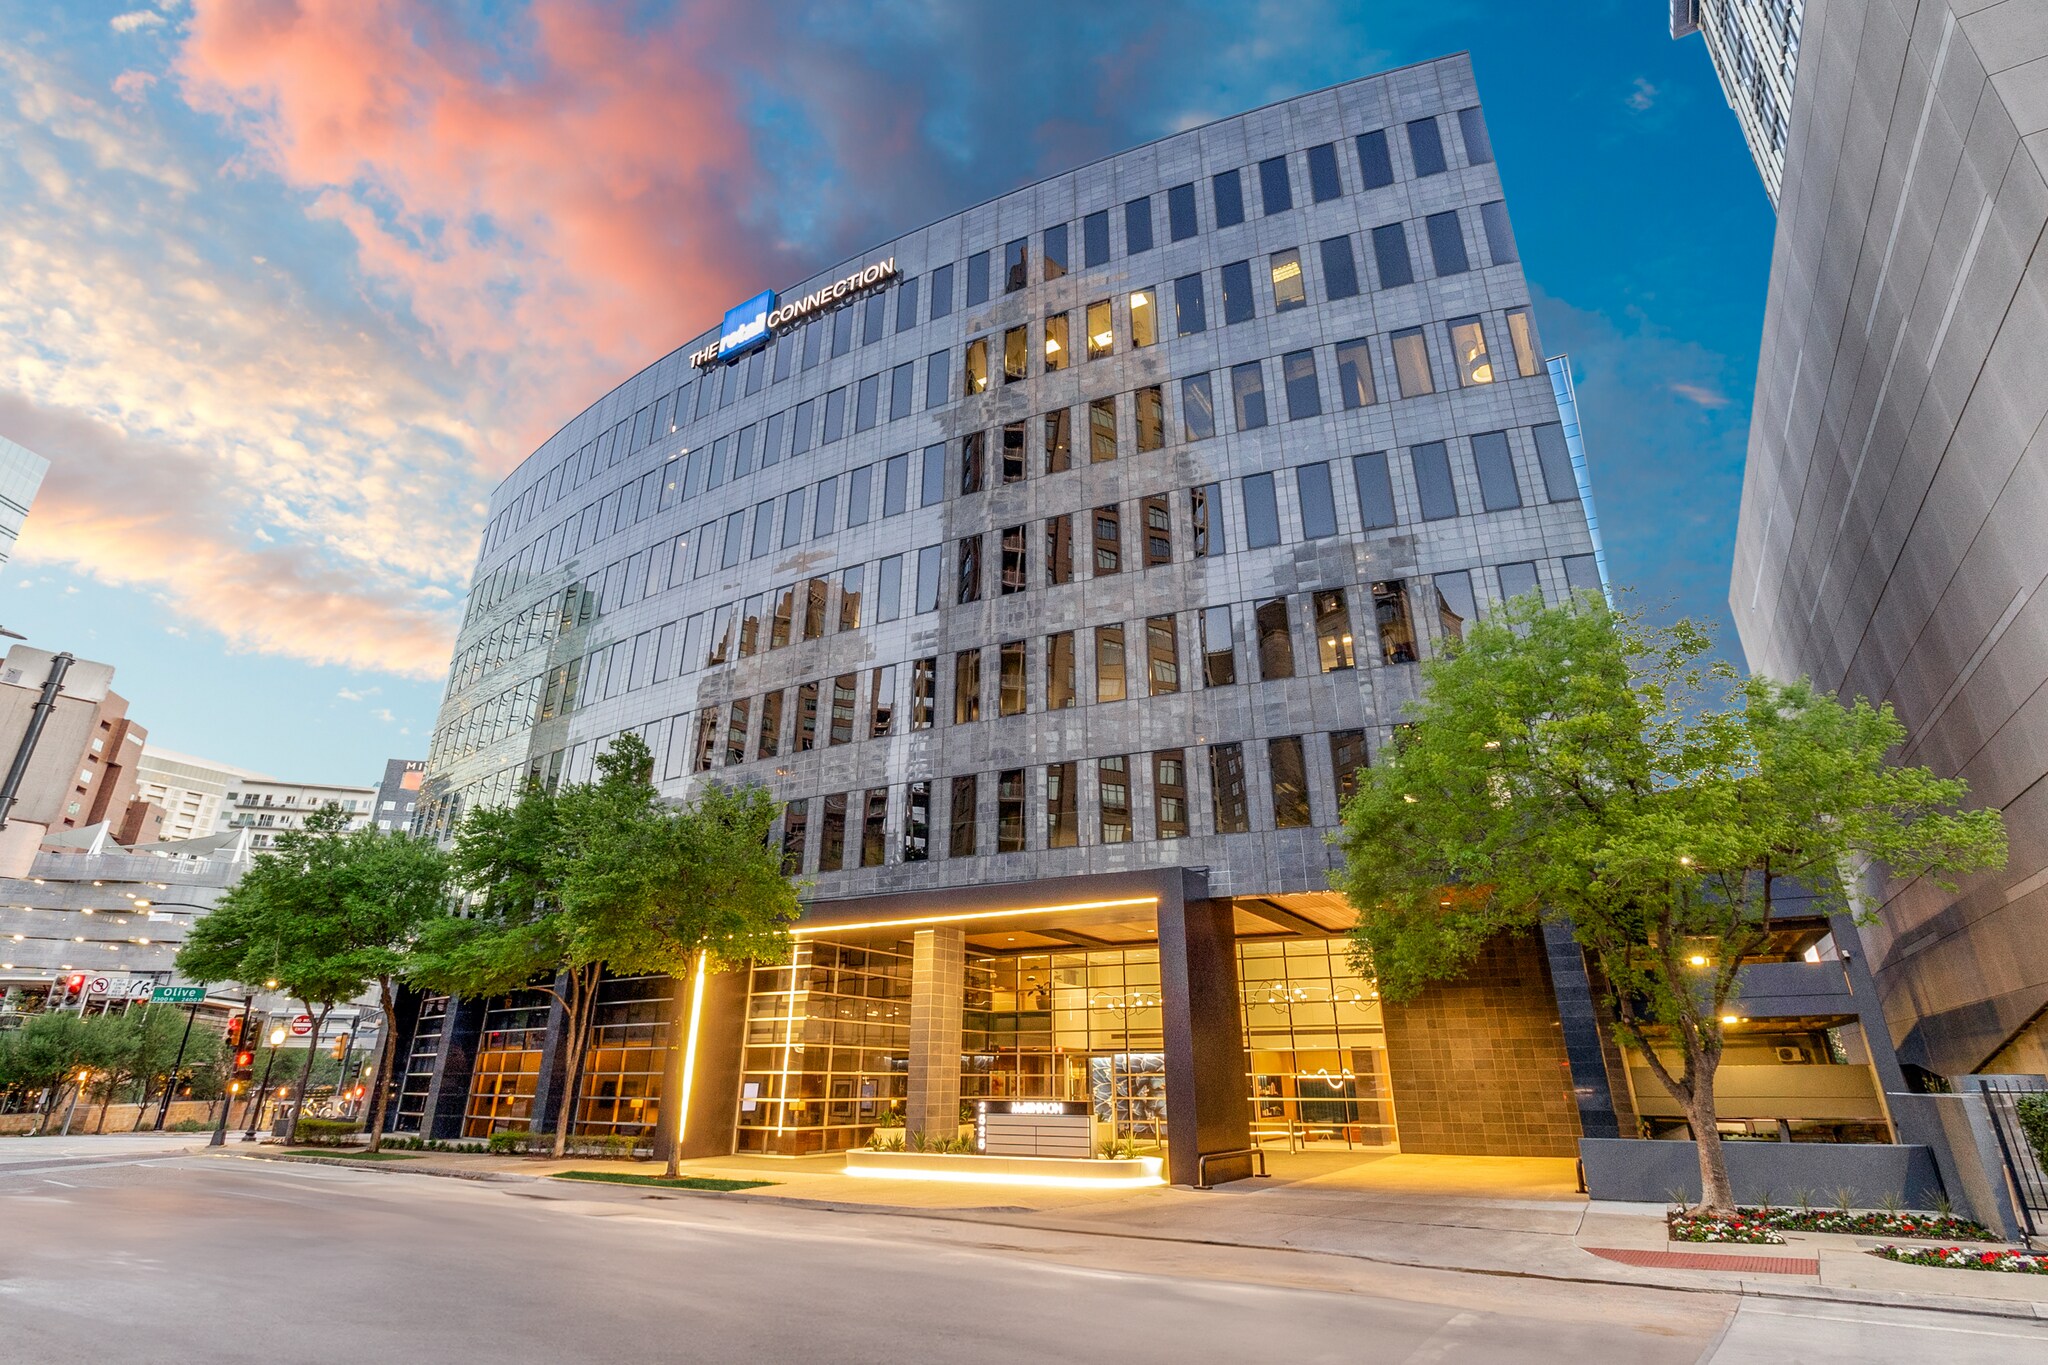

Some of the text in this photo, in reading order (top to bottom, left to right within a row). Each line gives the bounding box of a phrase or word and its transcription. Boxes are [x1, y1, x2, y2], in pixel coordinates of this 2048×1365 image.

[689, 341, 719, 369] THE
[766, 257, 895, 328] CONNECTION
[163, 987, 196, 997] Olive
